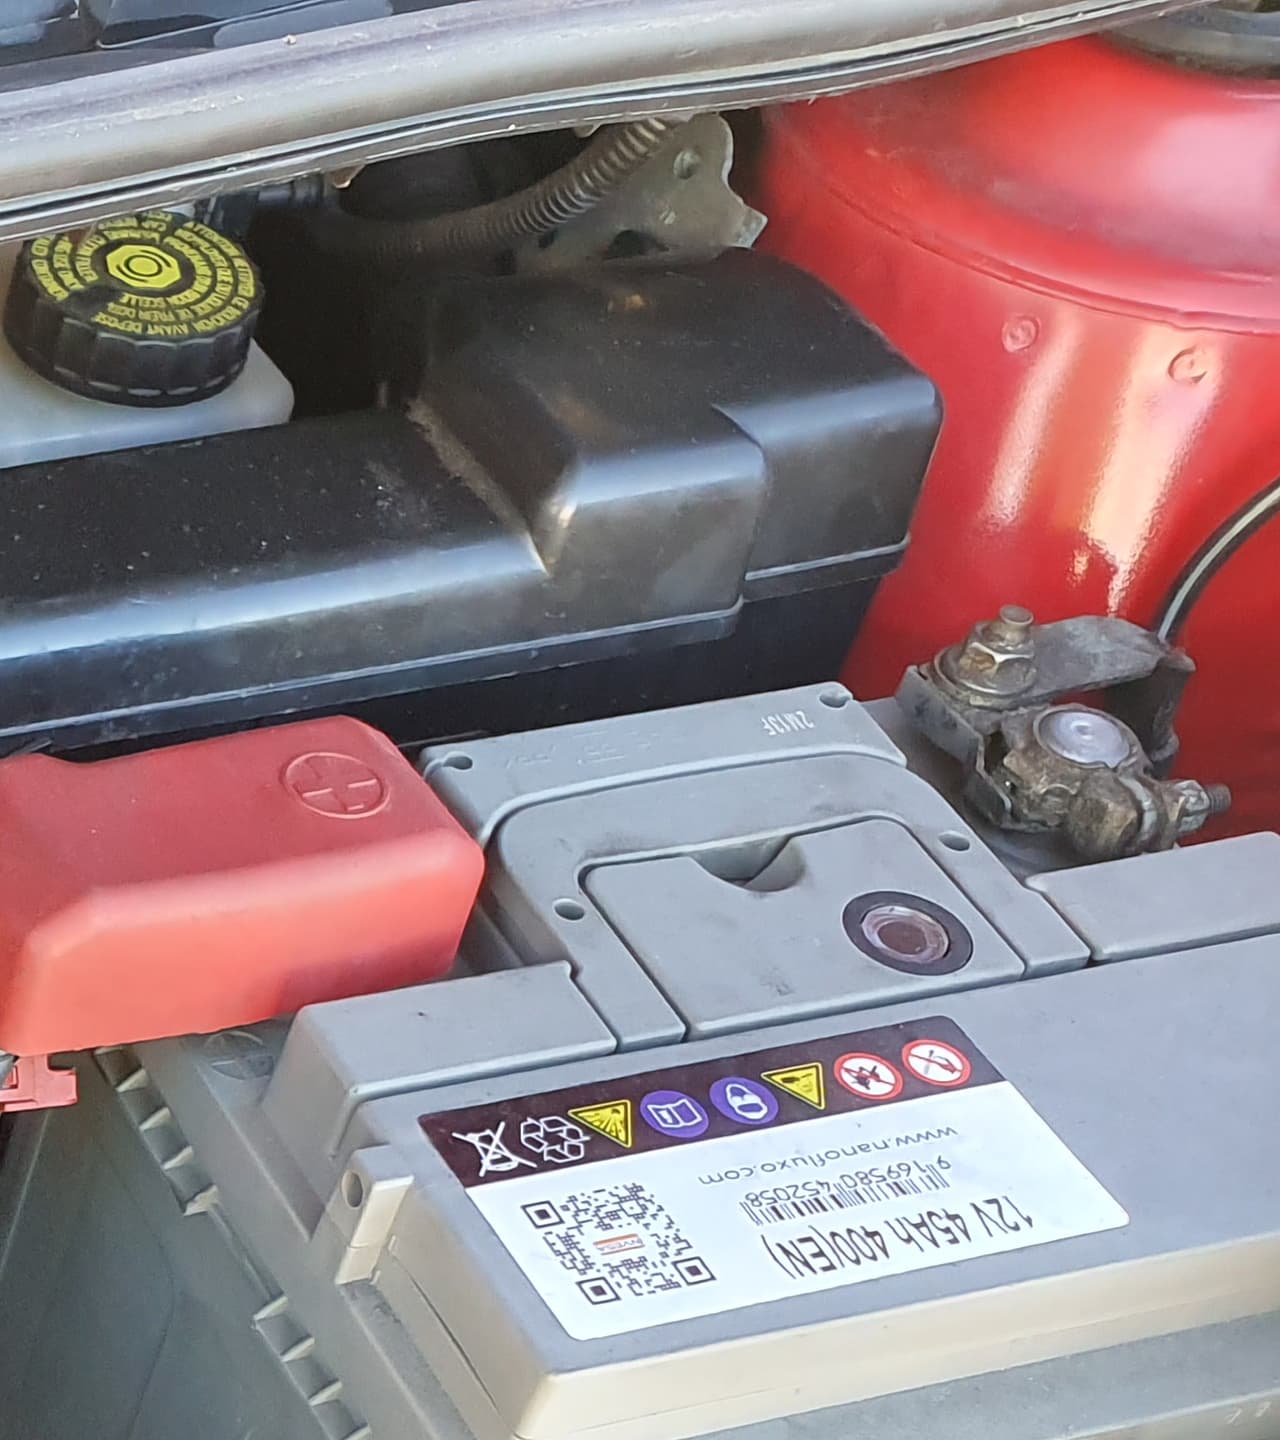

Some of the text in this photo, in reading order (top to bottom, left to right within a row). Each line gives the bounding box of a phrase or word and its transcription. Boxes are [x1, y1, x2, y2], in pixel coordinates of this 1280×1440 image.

[146, 323, 192, 335] AVANT
[697, 1126, 958, 1188] www.nanofluxo.com
[761, 1196, 1033, 1279] 12V 45Ah 400(EN)
